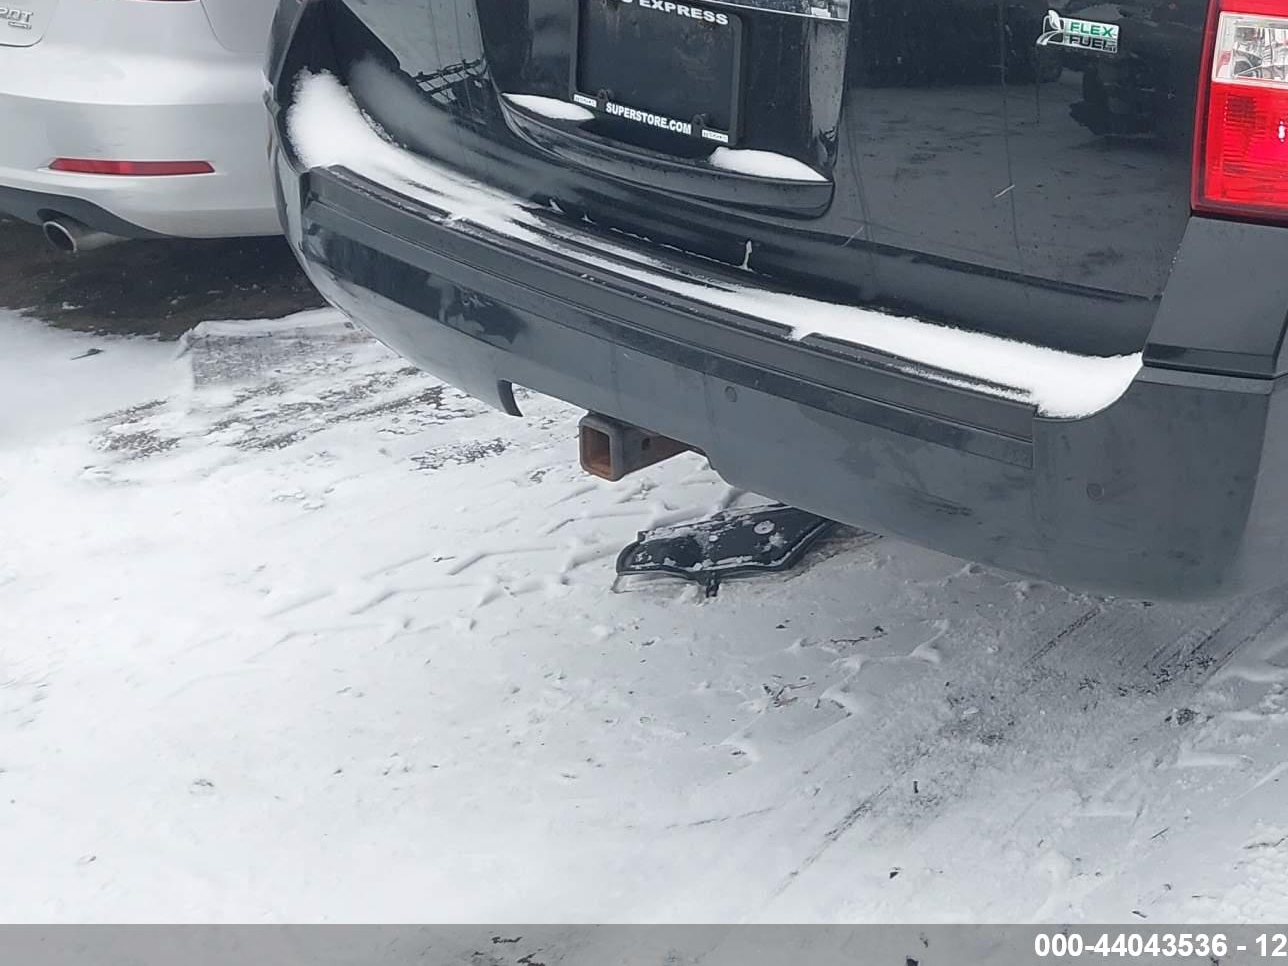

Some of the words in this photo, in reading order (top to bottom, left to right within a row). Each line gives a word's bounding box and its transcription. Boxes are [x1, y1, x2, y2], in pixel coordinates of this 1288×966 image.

[1070, 21, 1114, 37] FLEX
[1069, 34, 1117, 52] FUEL
[605, 101, 692, 135] SUPERSTORE.COM
